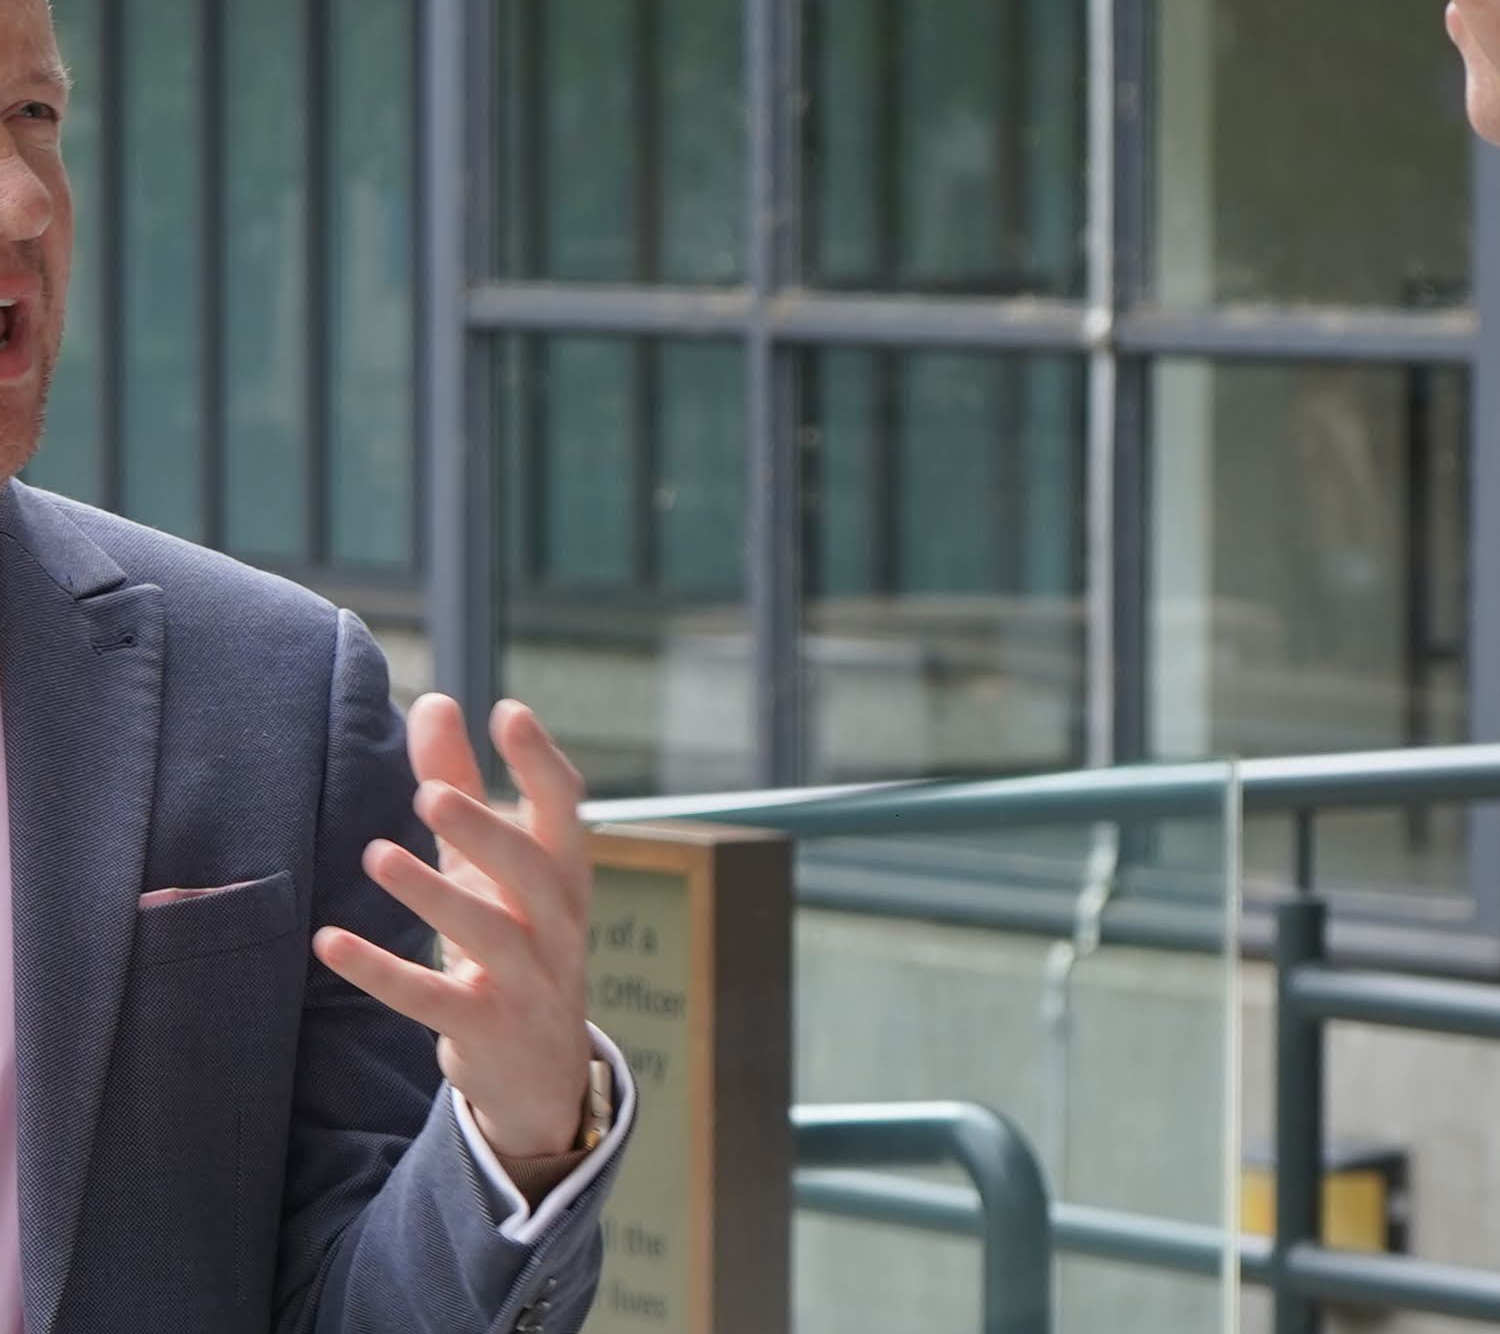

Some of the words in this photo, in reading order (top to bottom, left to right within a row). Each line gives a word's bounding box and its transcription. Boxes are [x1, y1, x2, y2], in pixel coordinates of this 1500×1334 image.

[599, 974, 687, 1019] Officer
[622, 1220, 665, 1259] the
[611, 1281, 668, 1319] lives
